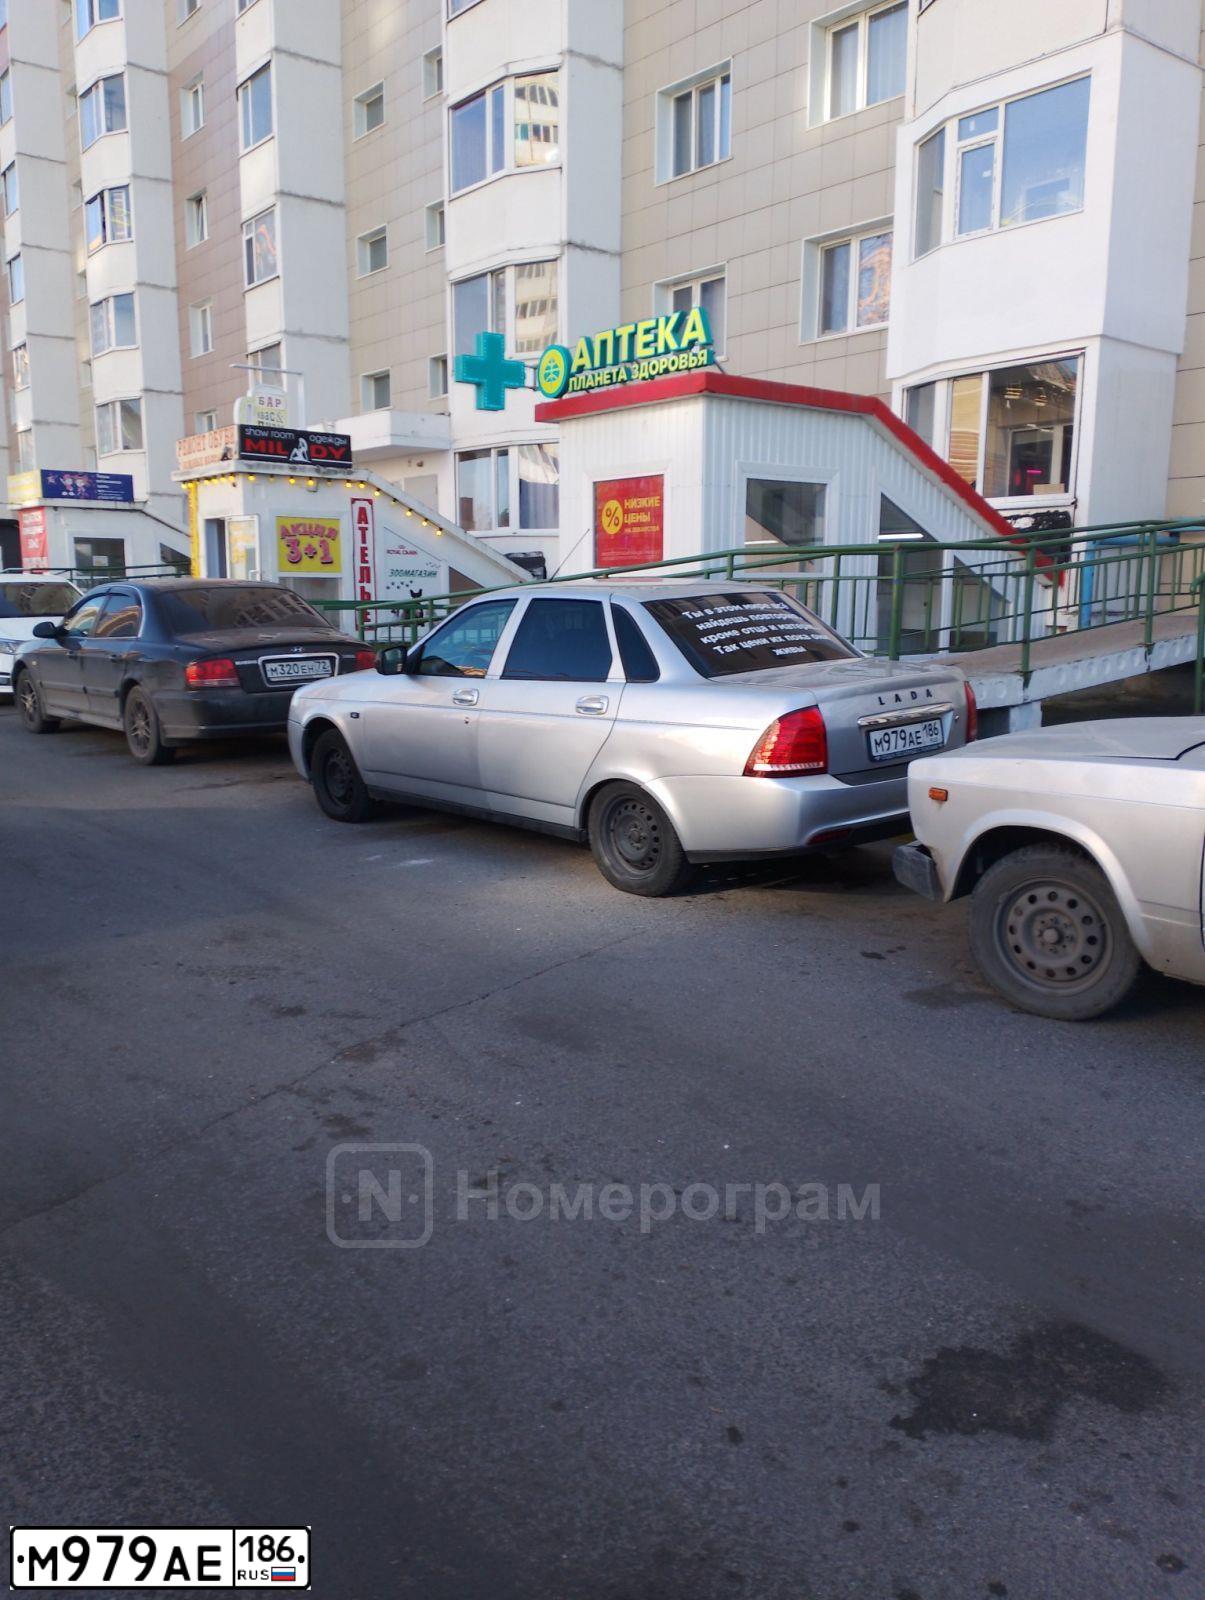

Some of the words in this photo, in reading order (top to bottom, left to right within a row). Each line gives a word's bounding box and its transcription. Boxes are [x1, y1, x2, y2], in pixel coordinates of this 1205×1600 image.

[571, 306, 711, 374] АПТЕКА
[568, 365, 627, 392] ПЛАНЕТА
[631, 349, 709, 381] ЗДОРОВЬЯ
[258, 396, 283, 408] БАР
[270, 430, 295, 440] room
[624, 496, 660, 509] НИЗКИЕ
[624, 512, 651, 524] ЦЕНЫ
[280, 523, 338, 541] АКЦИЯ
[286, 538, 334, 564] 3+1
[357, 506, 372, 623] АТЕЛЬЕ
[388, 569, 438, 578] ЗООМАГАЗИН
[682, 611, 704, 620] Ты
[704, 608, 714, 616] в
[715, 604, 743, 614] этом
[700, 628, 741, 645] кроме
[741, 624, 770, 635] отца
[712, 643, 740, 655] Так
[739, 638, 770, 650] цени
[769, 634, 787, 643] их
[786, 633, 812, 642] пока
[772, 646, 808, 656] живы
[270, 664, 314, 676] М320ЕН
[317, 661, 328, 670] 72
[878, 688, 933, 706] LADA
[874, 728, 922, 753] М979АЕ
[922, 722, 939, 738] 186
